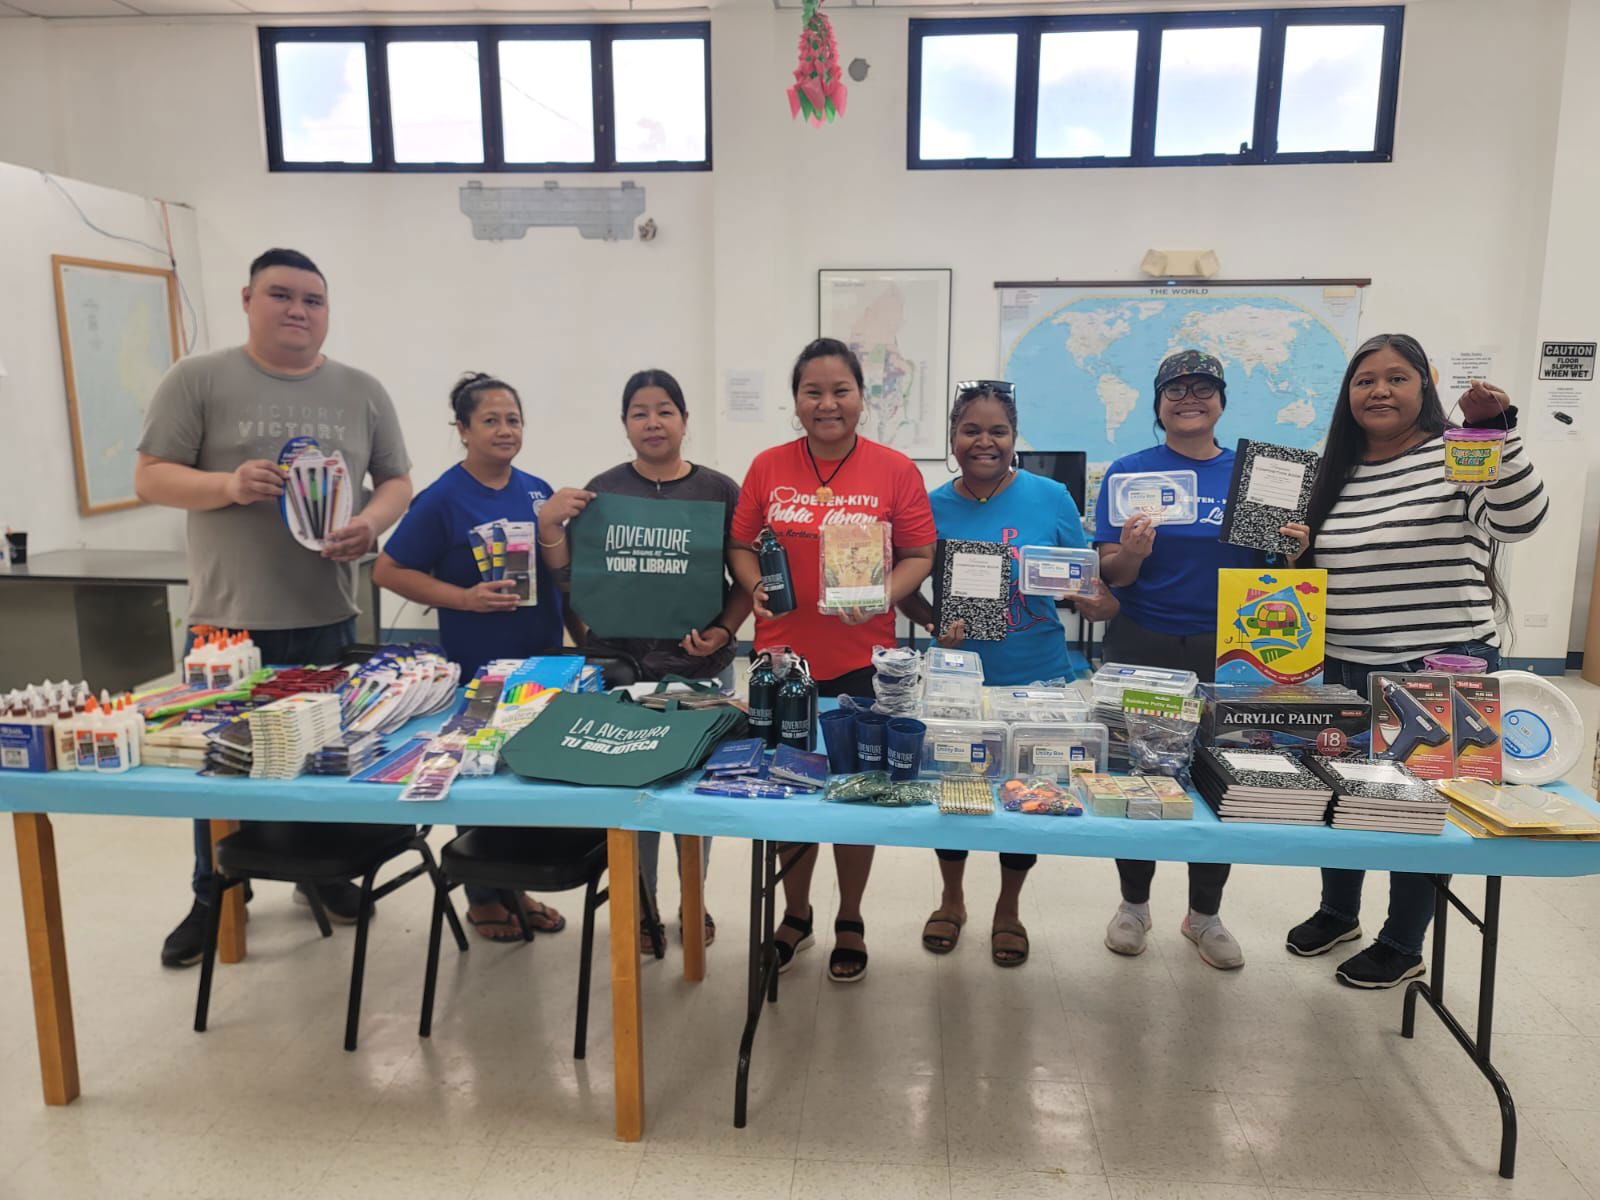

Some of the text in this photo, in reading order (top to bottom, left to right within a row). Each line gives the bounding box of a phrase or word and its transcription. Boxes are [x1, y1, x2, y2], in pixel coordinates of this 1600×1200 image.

[1545, 345, 1593, 356] CAUTION
[1544, 369, 1589, 378] WHEN WET
[238, 420, 346, 441] VICTORY
[768, 503, 814, 524] Public
[605, 524, 692, 554] ADVENTURE
[606, 556, 688, 574] YOUR LIBRARY
[1223, 713, 1333, 725] ACRYLIC PAINT
[569, 718, 671, 741] LA AVENTURA
[561, 735, 582, 748] TU
[580, 740, 660, 755] BIBLIOTECA
[1321, 732, 1341, 747] 18
